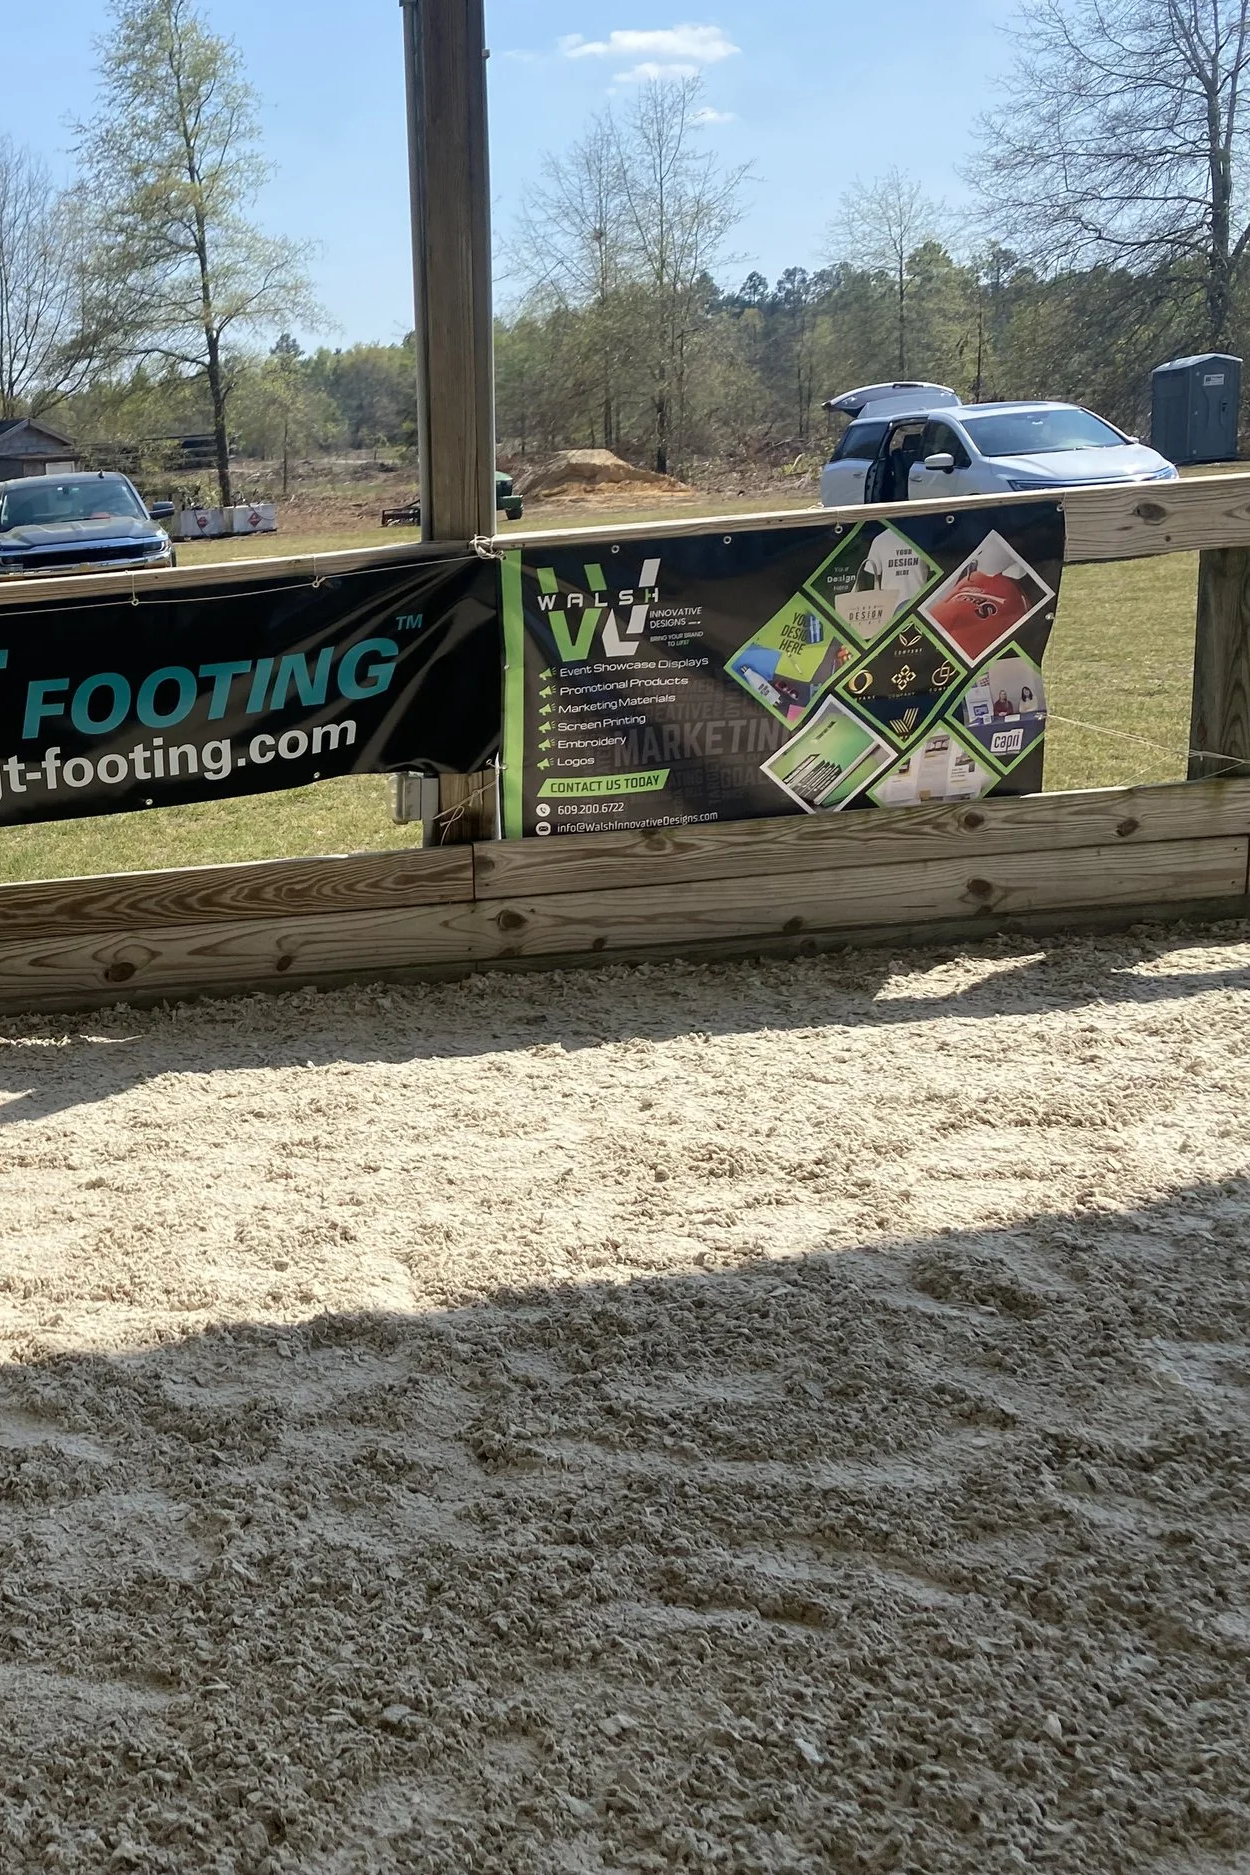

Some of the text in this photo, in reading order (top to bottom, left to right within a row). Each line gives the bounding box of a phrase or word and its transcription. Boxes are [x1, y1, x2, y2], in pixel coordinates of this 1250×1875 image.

[888, 557, 919, 568] DESIGN
[827, 574, 856, 583] Design
[537, 587, 659, 611] WALSH
[650, 607, 702, 618] INNOVATIVE
[849, 610, 883, 620] DESIGN
[650, 618, 686, 629] DESIGNS
[650, 631, 704, 642] BRING YOUR BRAND
[779, 638, 806, 655] HERE
[21, 638, 400, 739] FOOTING
[395, 612, 424, 631] TM
[560, 657, 709, 678] Event Showcase Displays
[559, 680, 629, 696] Promotional
[630, 677, 689, 688] Products
[558, 694, 676, 714] Marketing Materials
[557, 714, 646, 732] Screen Printing
[558, 736, 627, 749] Embroidery
[614, 718, 788, 767] MARKETIN
[994, 732, 1021, 751] capri
[557, 757, 595, 767] Logos
[550, 781, 602, 793] CONTACT
[606, 779, 621, 790] US
[624, 775, 660, 789] TODAY
[557, 802, 625, 815] 609.200.6722
[557, 811, 718, 833] info@WalshInnovativeDesigns.com
